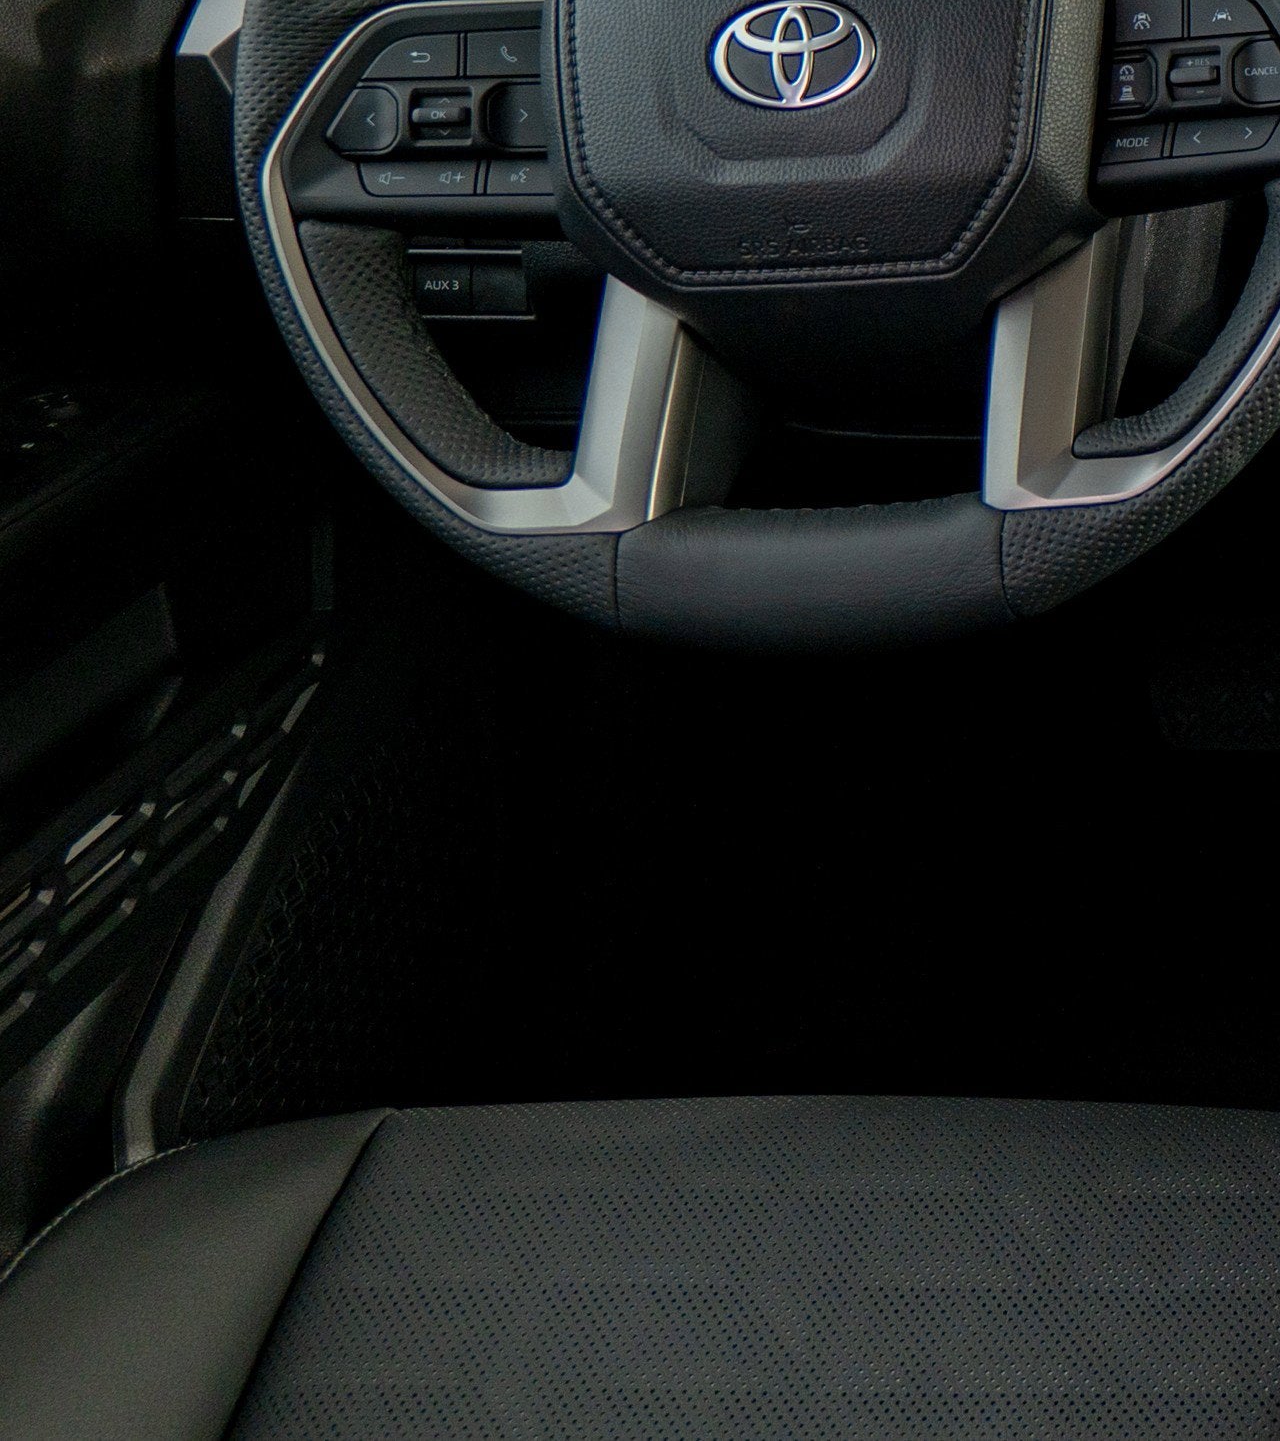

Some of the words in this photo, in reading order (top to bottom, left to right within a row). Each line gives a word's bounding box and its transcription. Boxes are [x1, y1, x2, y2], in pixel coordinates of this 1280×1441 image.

[1244, 64, 1279, 77] CANCEL
[431, 110, 446, 119] OK
[1116, 135, 1150, 148] MODE
[425, 280, 448, 291] AUX
[452, 280, 459, 291] 3
